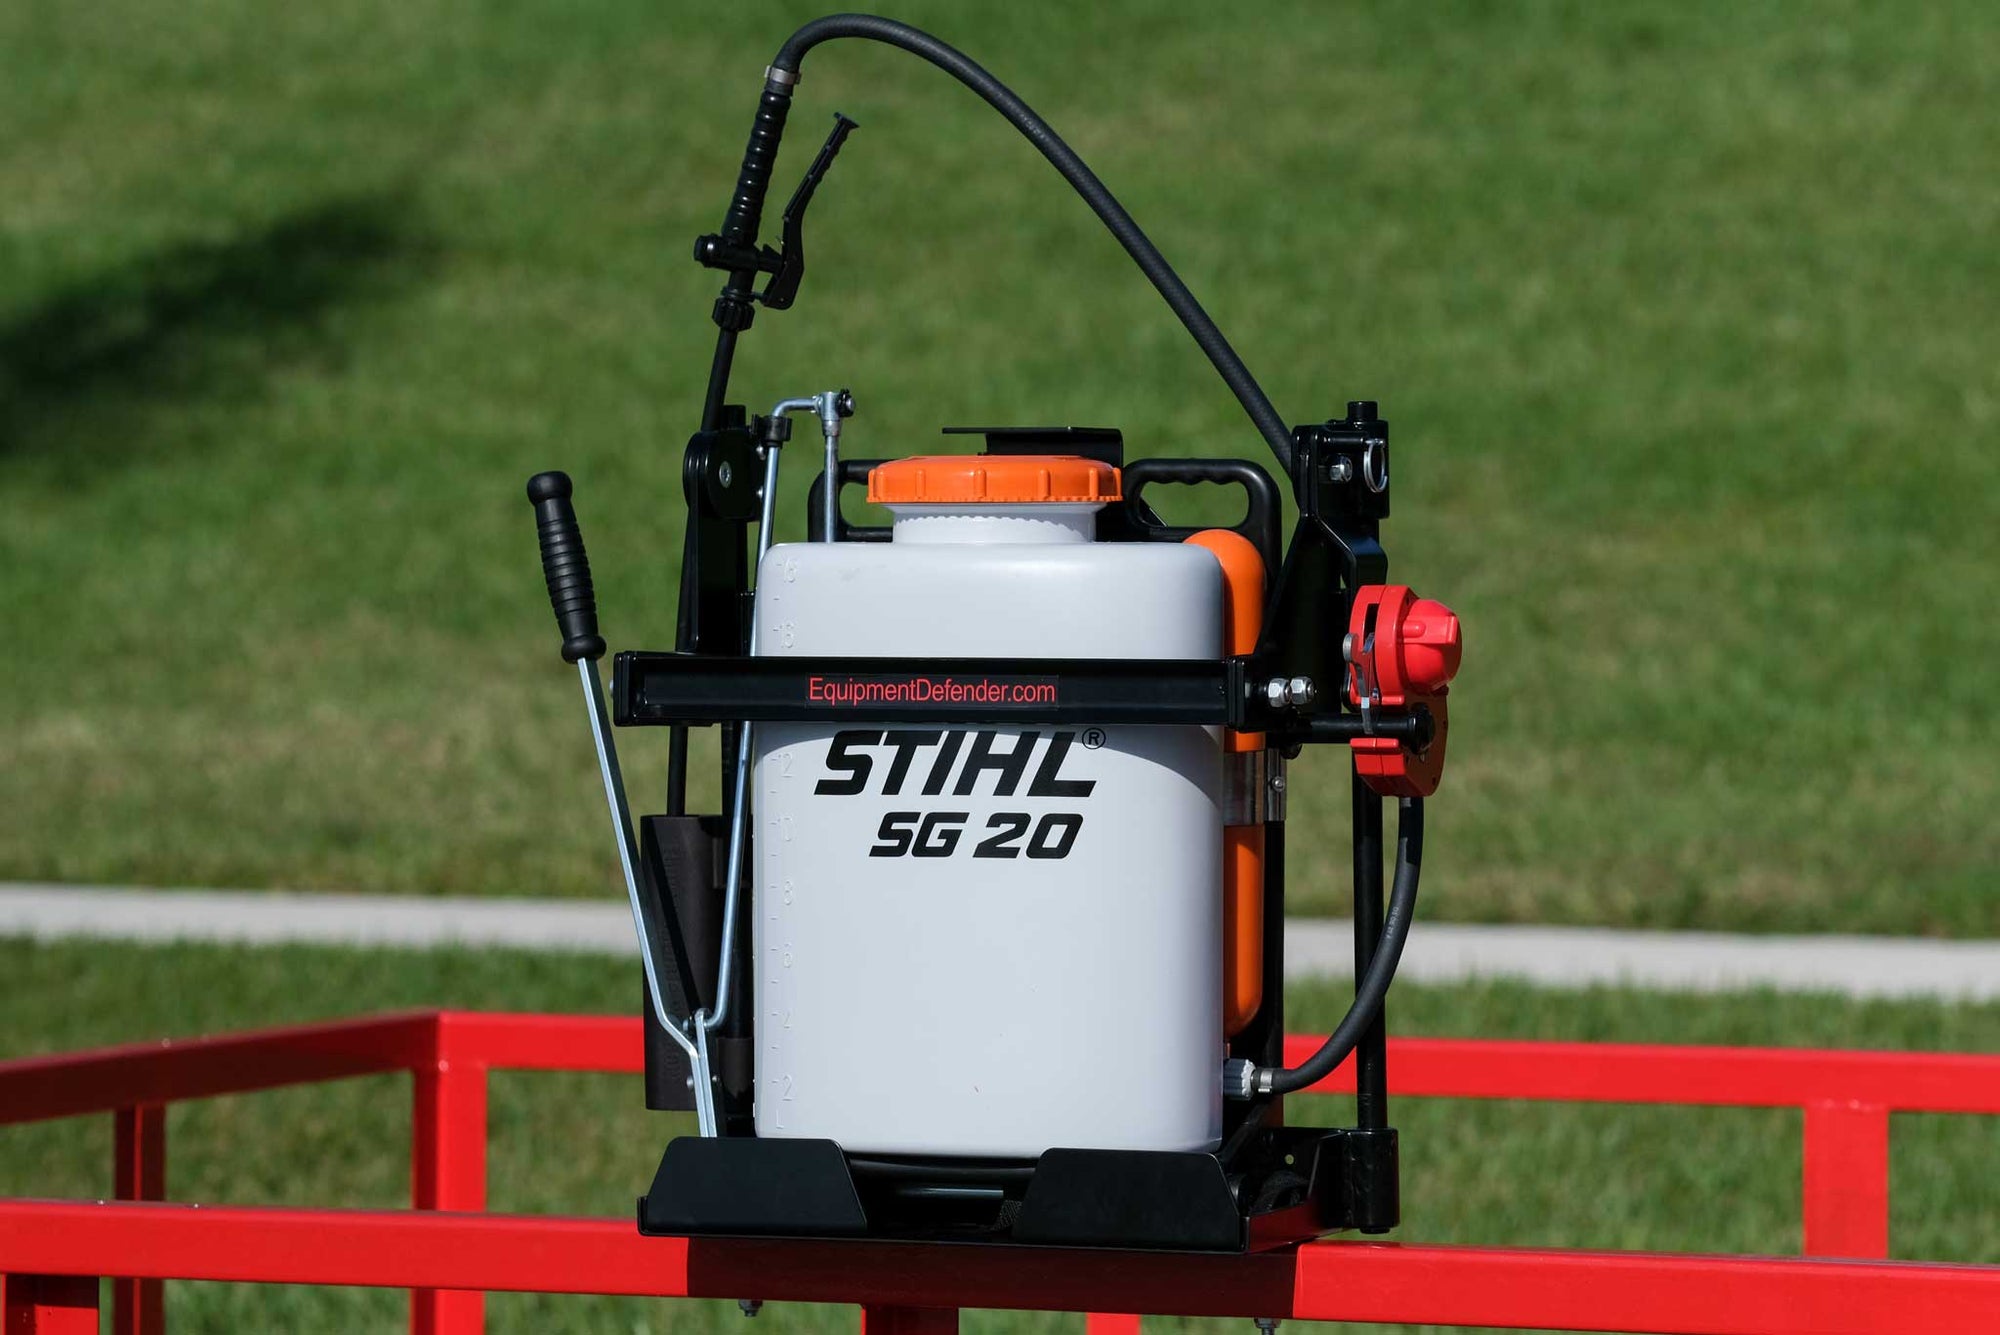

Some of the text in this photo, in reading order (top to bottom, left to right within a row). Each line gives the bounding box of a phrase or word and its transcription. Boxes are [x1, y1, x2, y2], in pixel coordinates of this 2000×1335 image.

[809, 676, 1056, 704] EquipmentDefender.com
[814, 730, 1097, 797] STIHL
[869, 812, 1083, 859] SG 20
